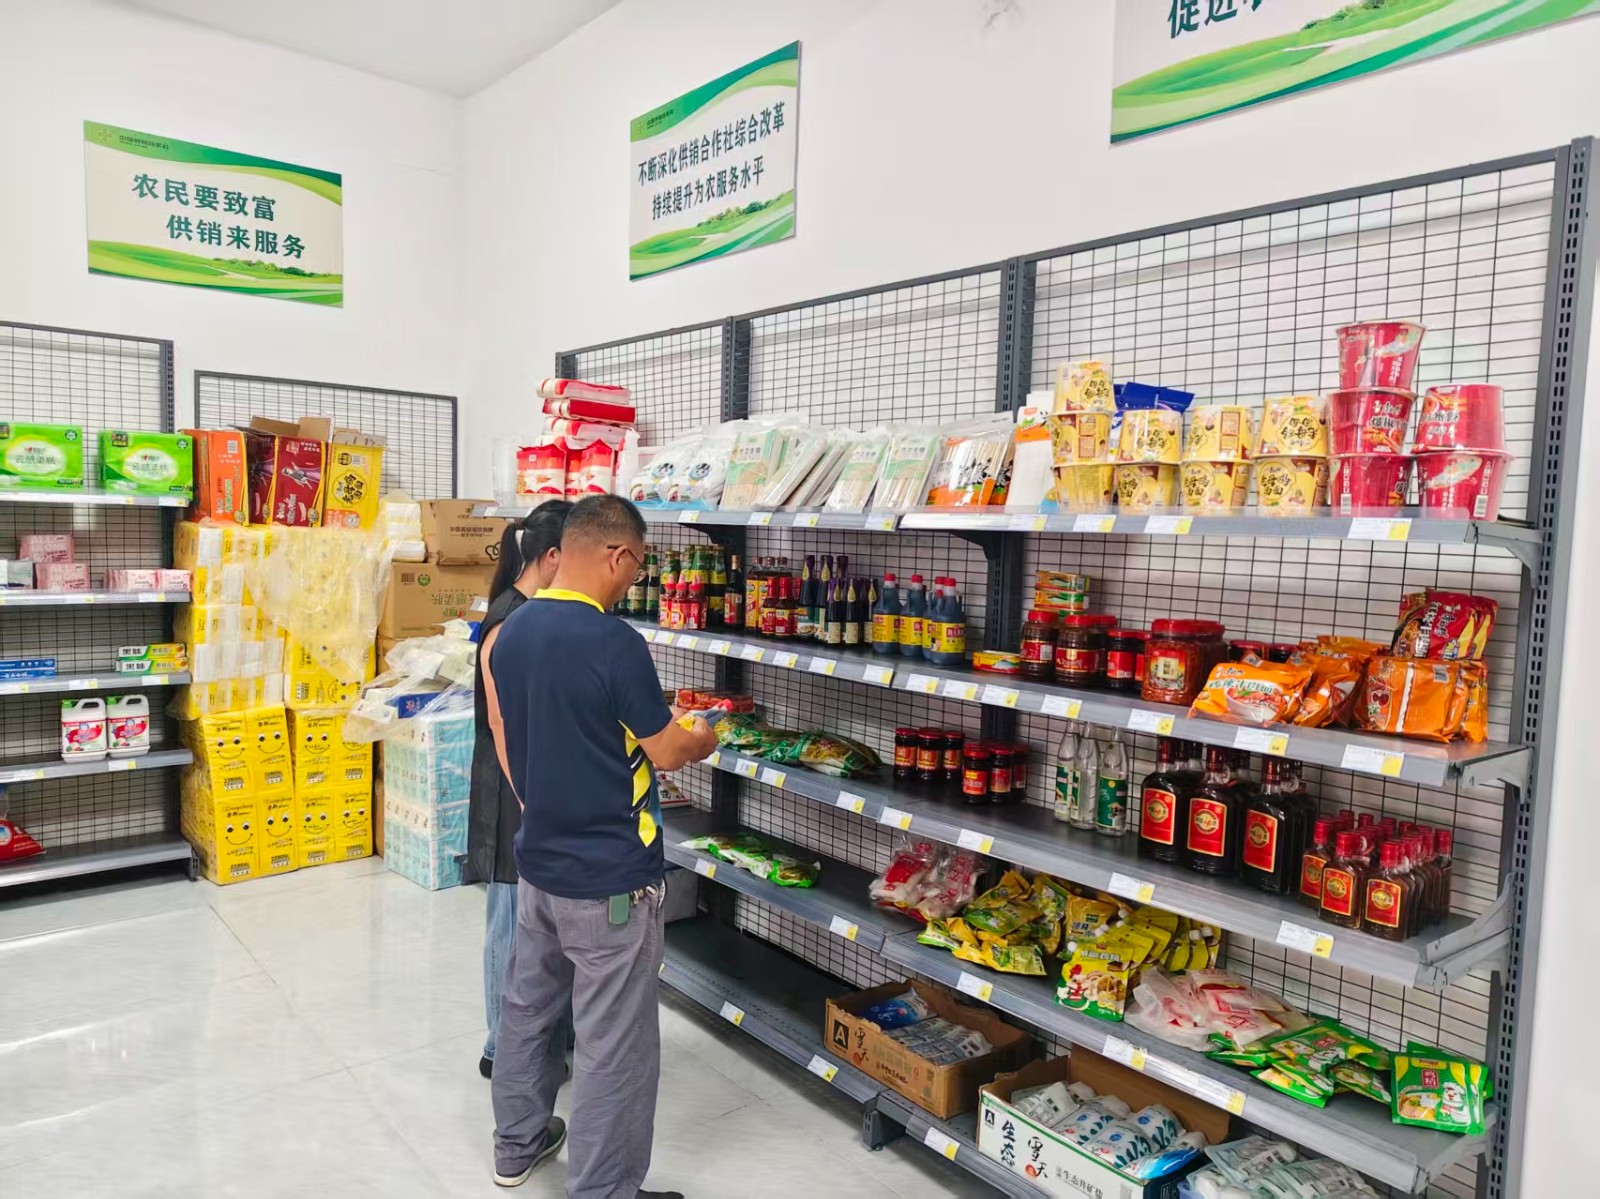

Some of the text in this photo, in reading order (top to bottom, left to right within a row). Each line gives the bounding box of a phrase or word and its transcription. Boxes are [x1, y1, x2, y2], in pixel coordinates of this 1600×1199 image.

[1167, 0, 1262, 38] 促进
[638, 101, 785, 186] 不断深化供销合作社综合改革
[131, 173, 276, 221] 农民要致富
[652, 155, 764, 220] 持续提升为农服务水平
[166, 214, 306, 259] 供销来服务
[835, 1024, 847, 1046] A
[1000, 1120, 1017, 1167] 生态
[1027, 1136, 1049, 1179] 雪天
